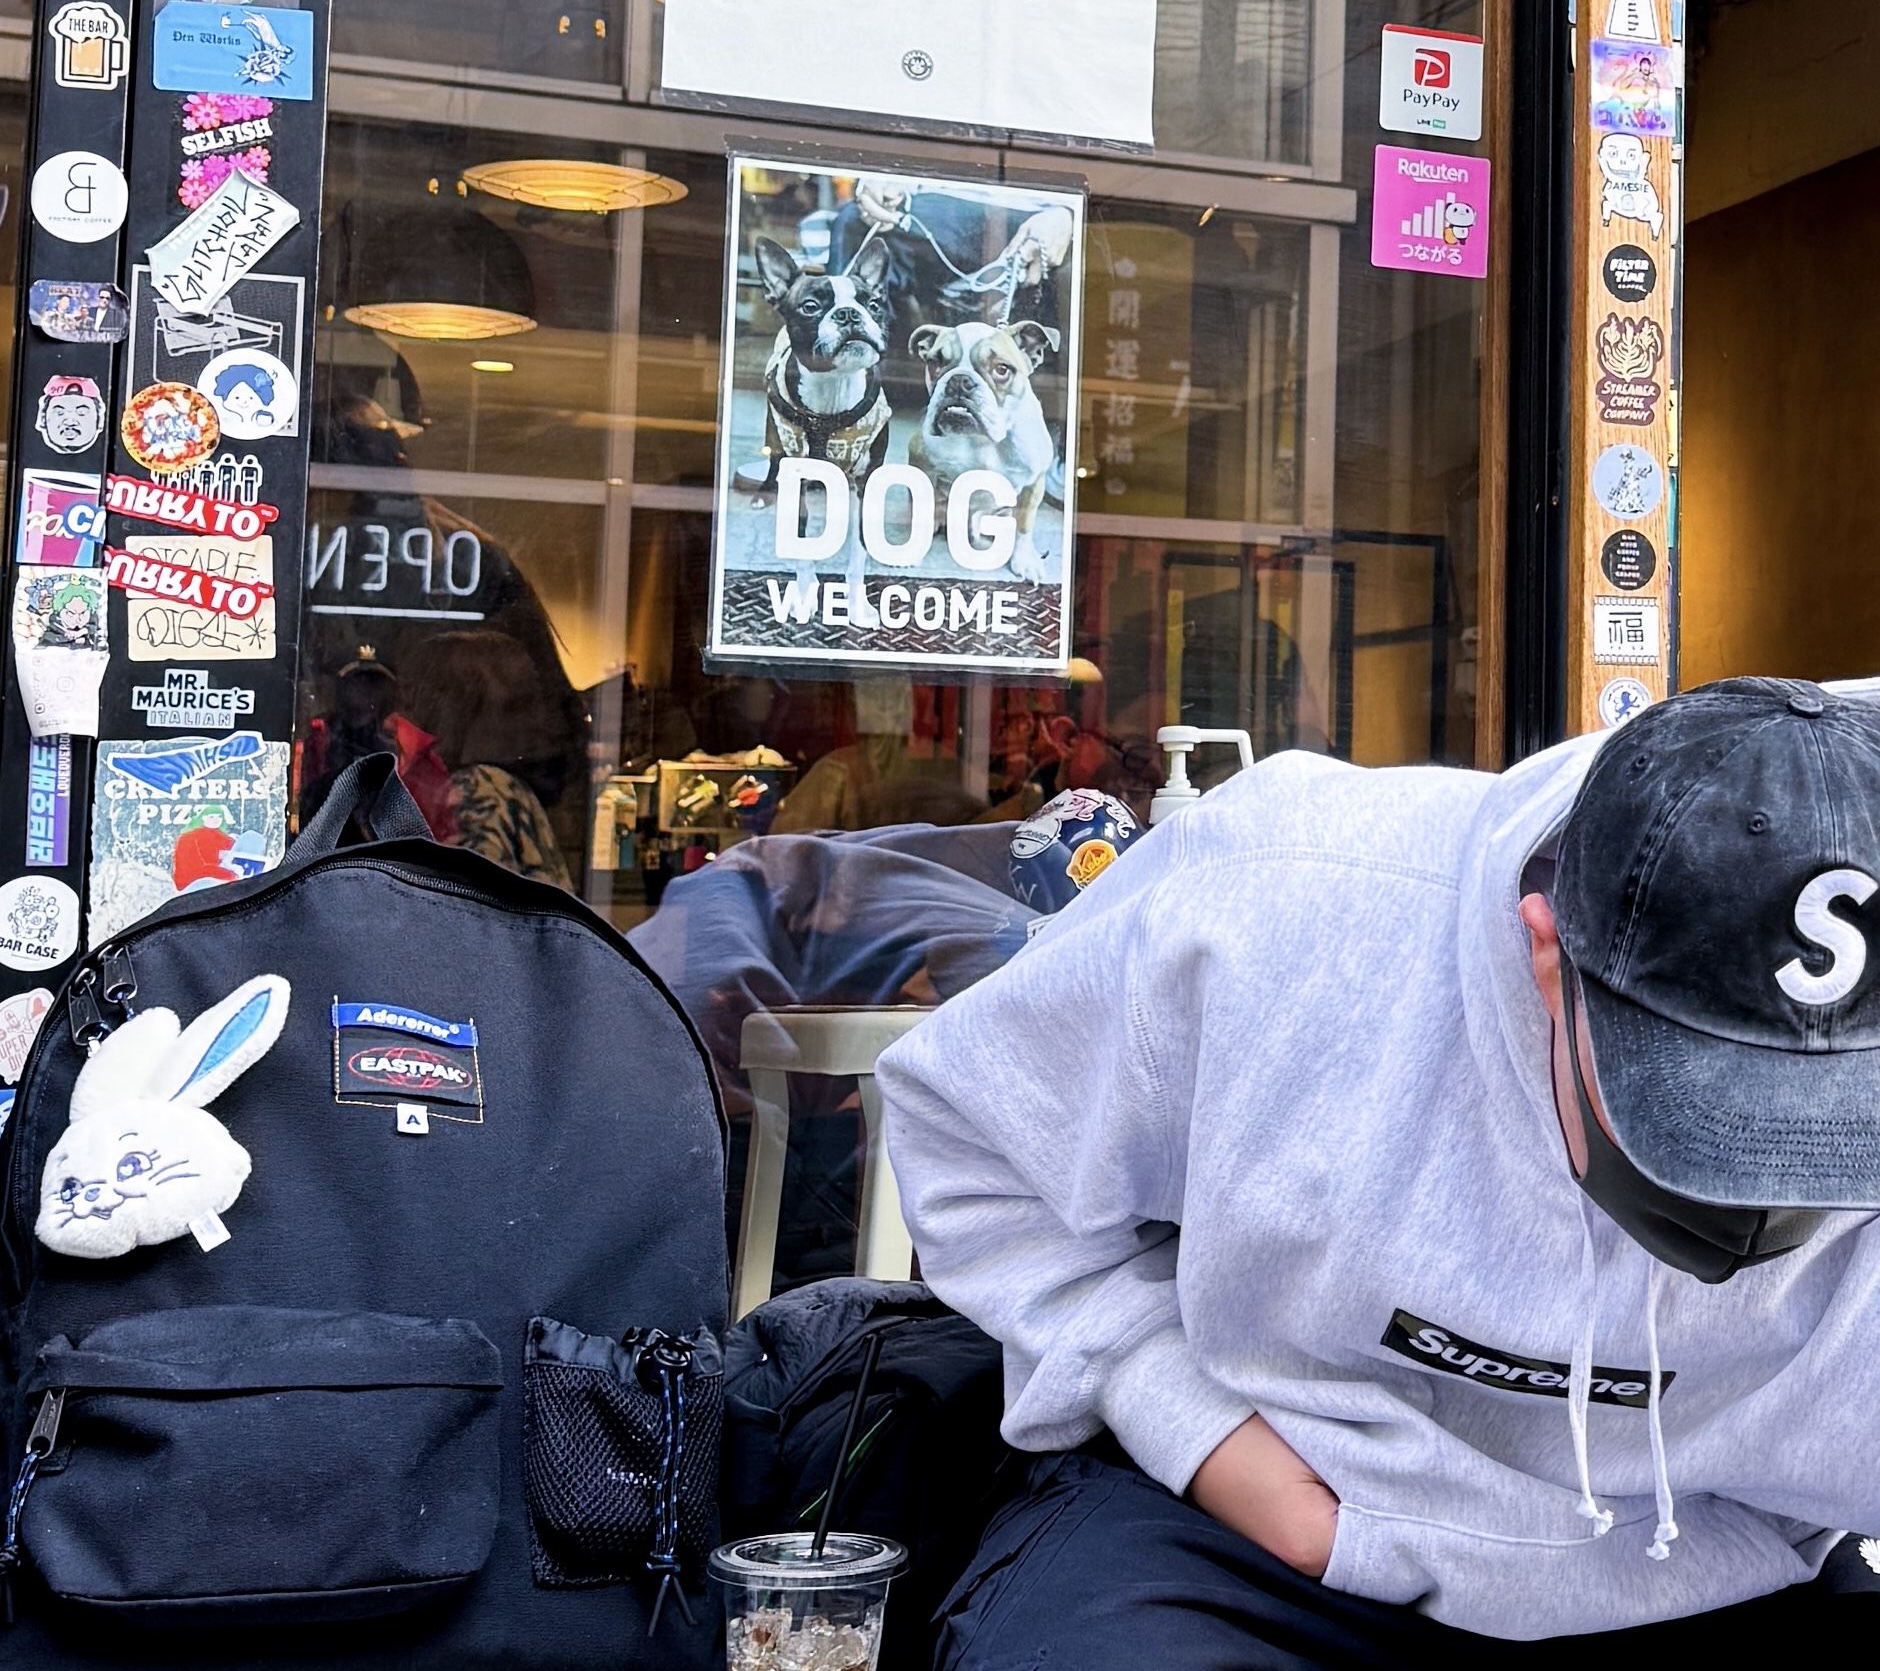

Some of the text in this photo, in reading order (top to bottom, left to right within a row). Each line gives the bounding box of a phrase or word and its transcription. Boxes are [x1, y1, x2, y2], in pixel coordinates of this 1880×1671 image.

[68, 17, 109, 35] THE BAR
[1403, 88, 1460, 112] PayPay
[180, 117, 273, 156] SELFISH
[1397, 157, 1469, 183] Rakuten
[1397, 242, 1463, 266] つながる
[775, 456, 1018, 571] DOG
[766, 578, 1020, 634] WELCOME
[166, 672, 205, 691] MR.
[135, 687, 251, 710] MAURICE'S
[150, 710, 232, 726] ITALIAN
[103, 778, 271, 801] CRTERS
[137, 803, 237, 826] PIZA
[1774, 868, 1879, 1006] S
[26, 944, 60, 959] CASE
[360, 1056, 468, 1084] EASTPAK
[406, 1114, 421, 1126] A
